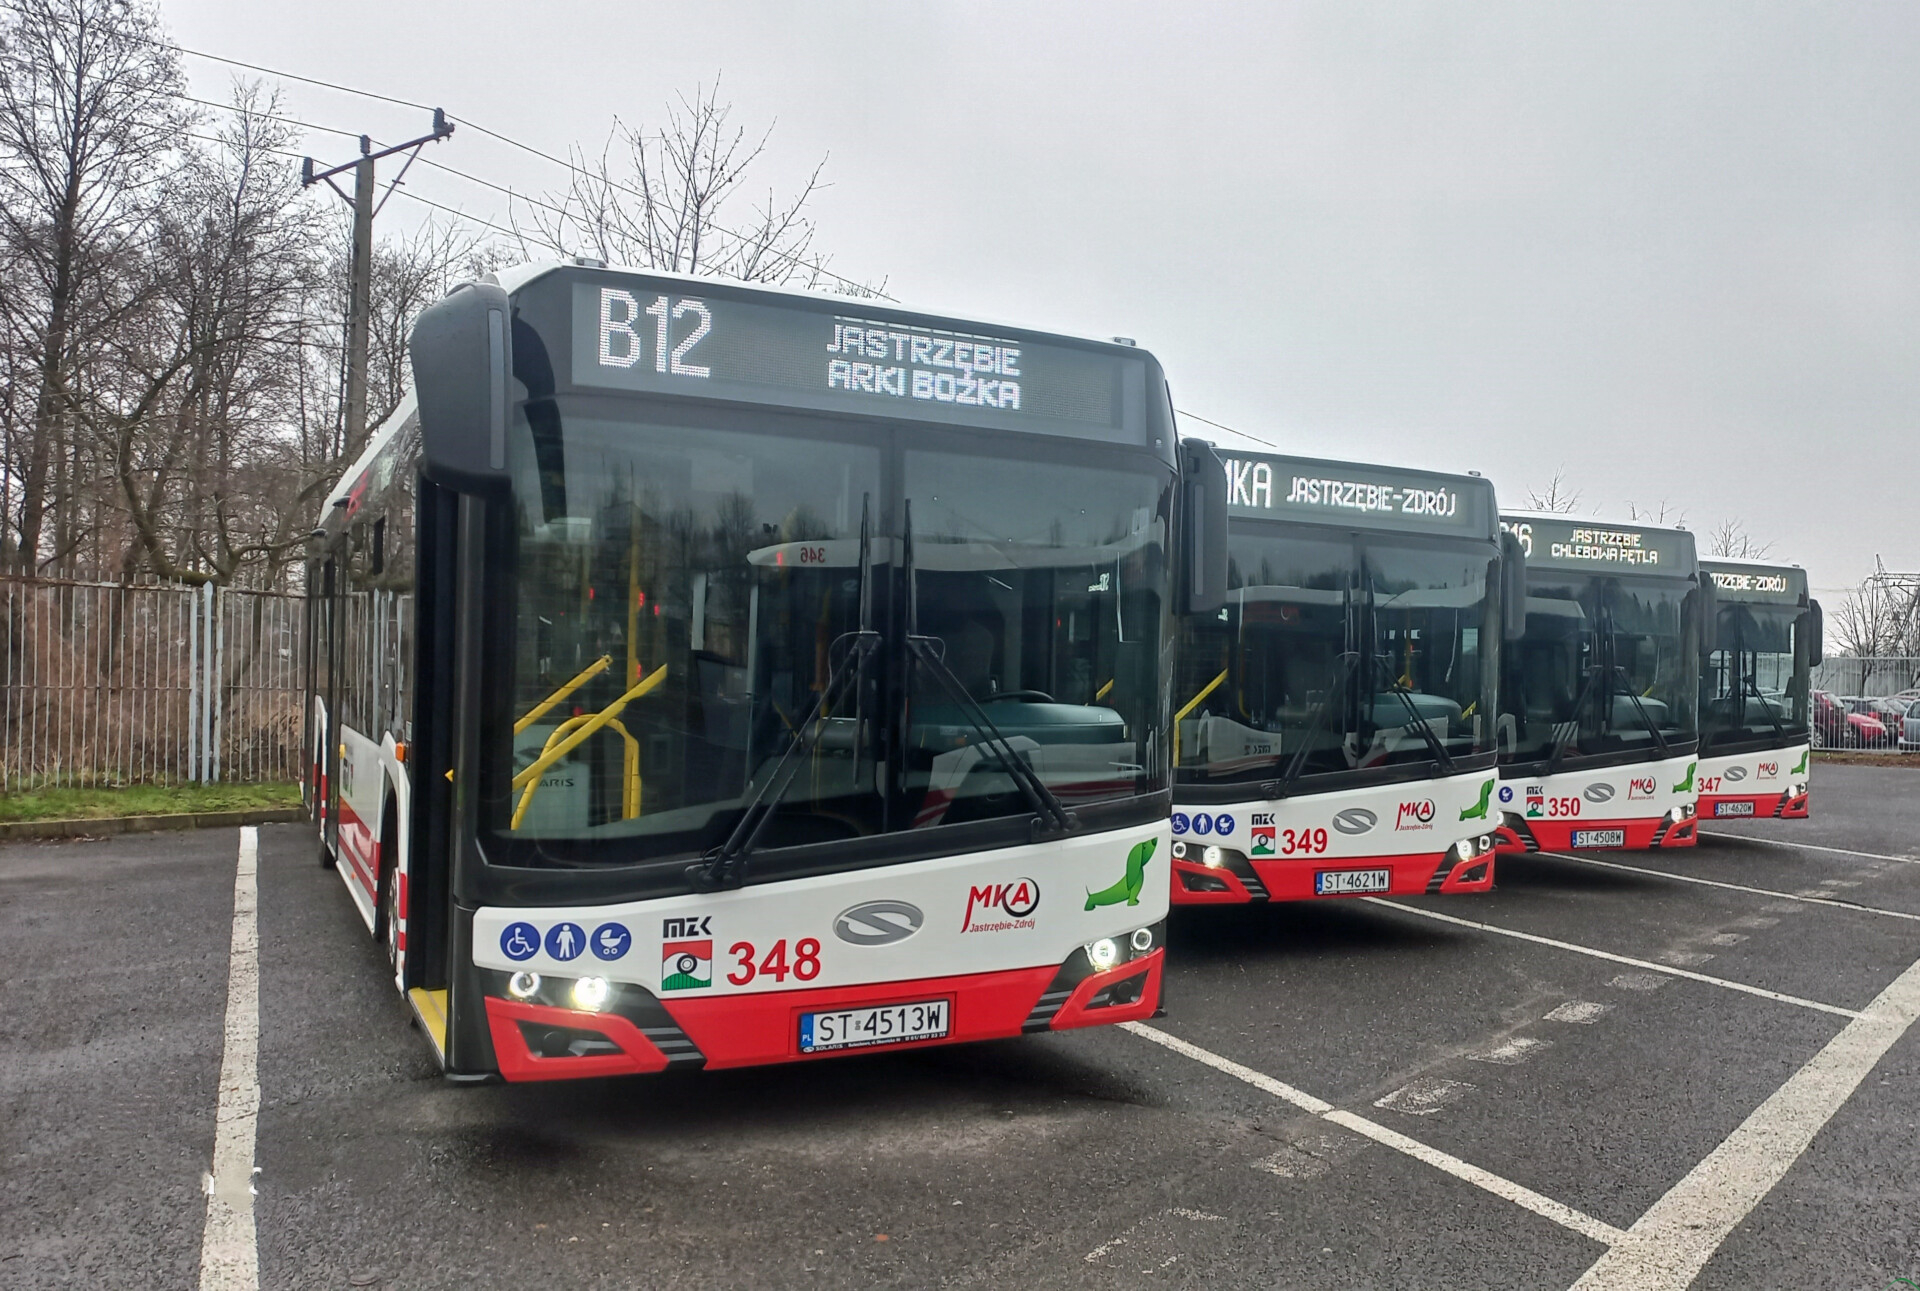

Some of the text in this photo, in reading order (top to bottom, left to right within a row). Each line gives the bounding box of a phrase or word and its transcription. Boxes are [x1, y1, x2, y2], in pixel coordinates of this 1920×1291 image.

[599, 287, 711, 378] B12
[828, 359, 905, 397] ARKI
[1287, 477, 1456, 516] JASTRZĘBIE-ZDRÓJ
[1570, 528, 1641, 549] JASTRZĘBIE
[1551, 543, 1658, 564] CHLEBOWA PĘTLA
[1710, 573, 1786, 592] TRZĘBIE-ZDRÓJ
[538, 779, 574, 787] ARIS
[1628, 776, 1656, 800] MKA
[1698, 777, 1721, 792] 347
[1395, 798, 1435, 831] MKA
[1548, 797, 1580, 816] 350
[1281, 827, 1328, 855] 349
[960, 877, 1040, 934] MKA
[969, 918, 1036, 933] Jastrzębie-Zdrój
[727, 937, 821, 986] 348
